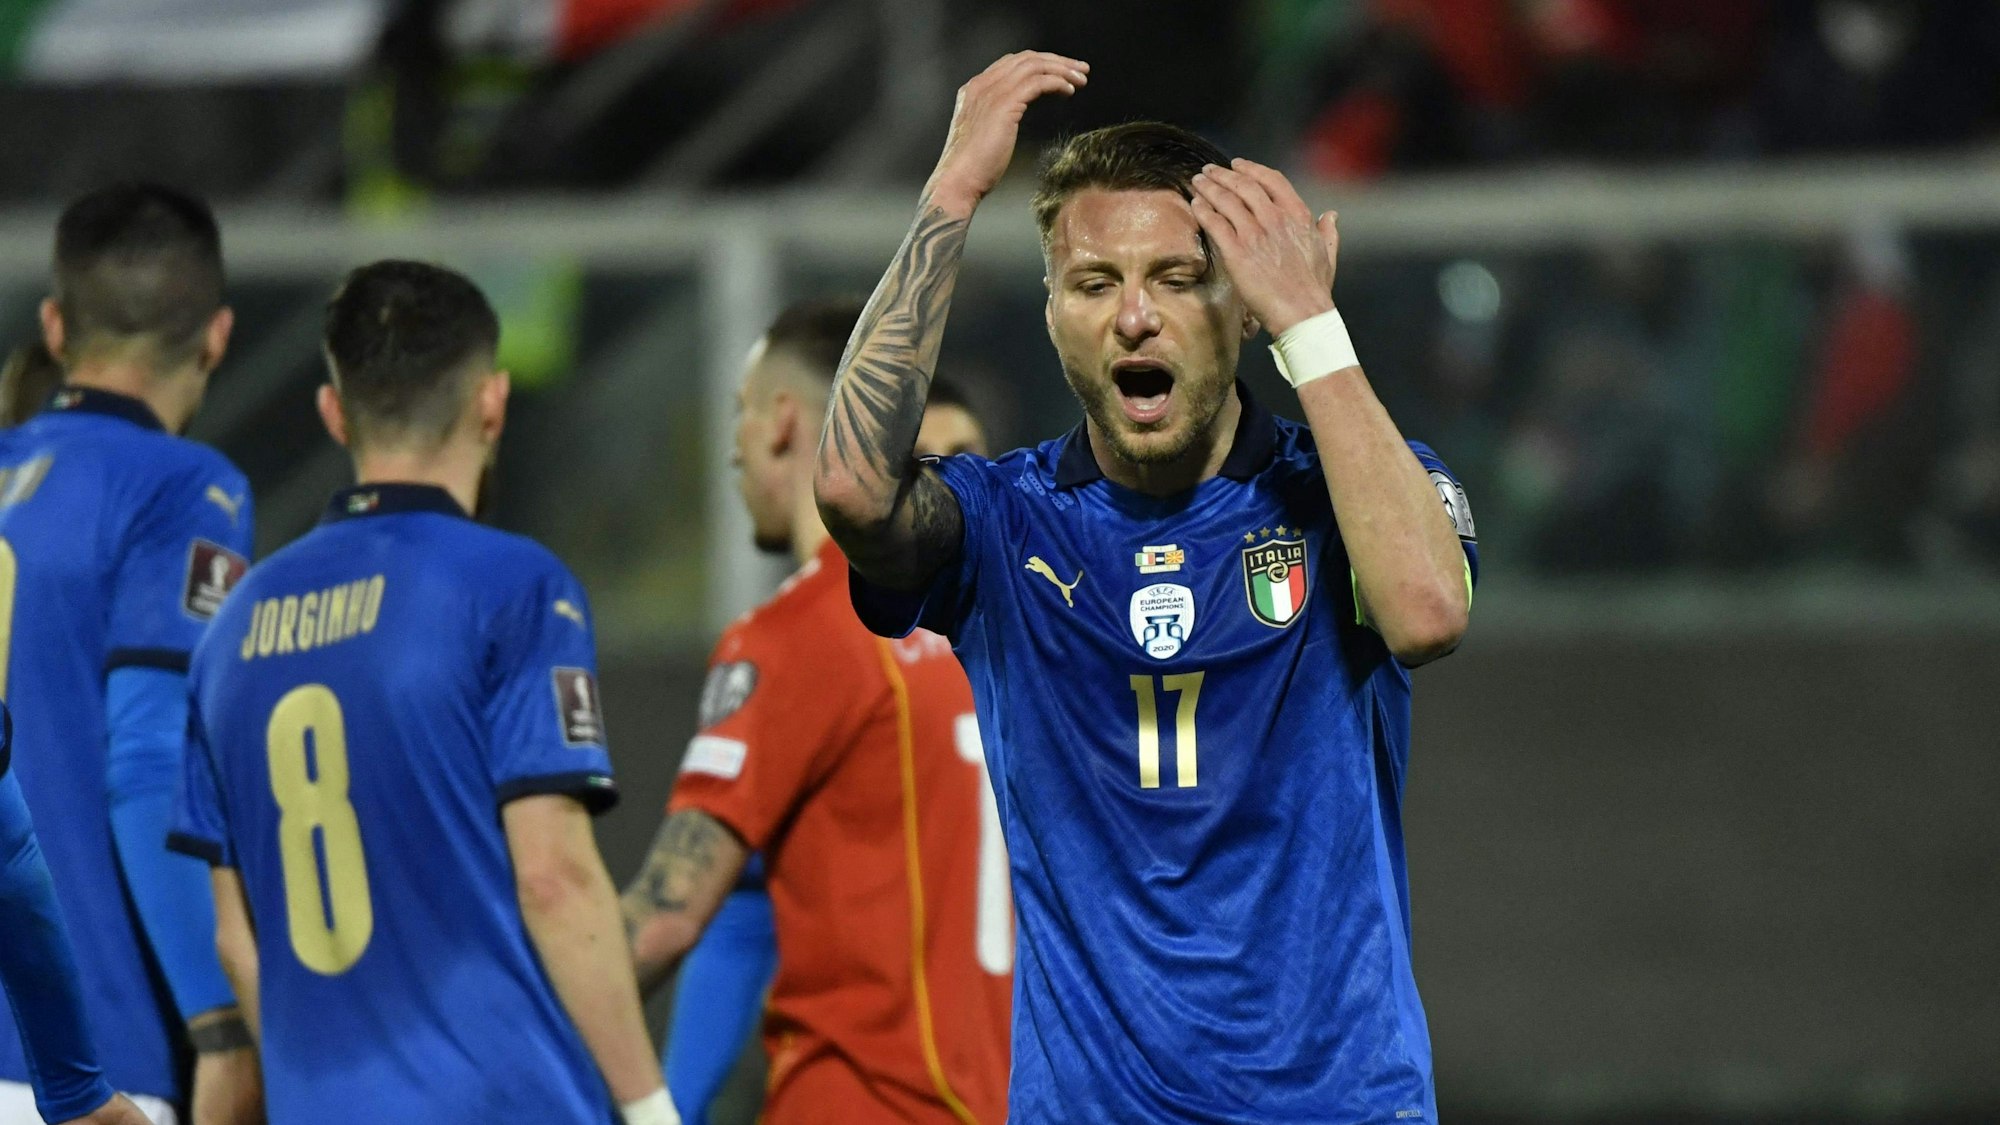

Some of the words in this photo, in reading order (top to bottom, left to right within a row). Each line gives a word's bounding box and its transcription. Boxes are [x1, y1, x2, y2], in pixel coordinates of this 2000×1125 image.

[1249, 547, 1301, 567] ITALIA
[1140, 596, 1184, 605] EUROPEAN
[1149, 586, 1174, 597] UEFA
[241, 574, 386, 661] JORGINHO
[1140, 603, 1184, 612] CHAMPIONS
[1129, 671, 1205, 788] 17
[266, 683, 374, 976] 8
